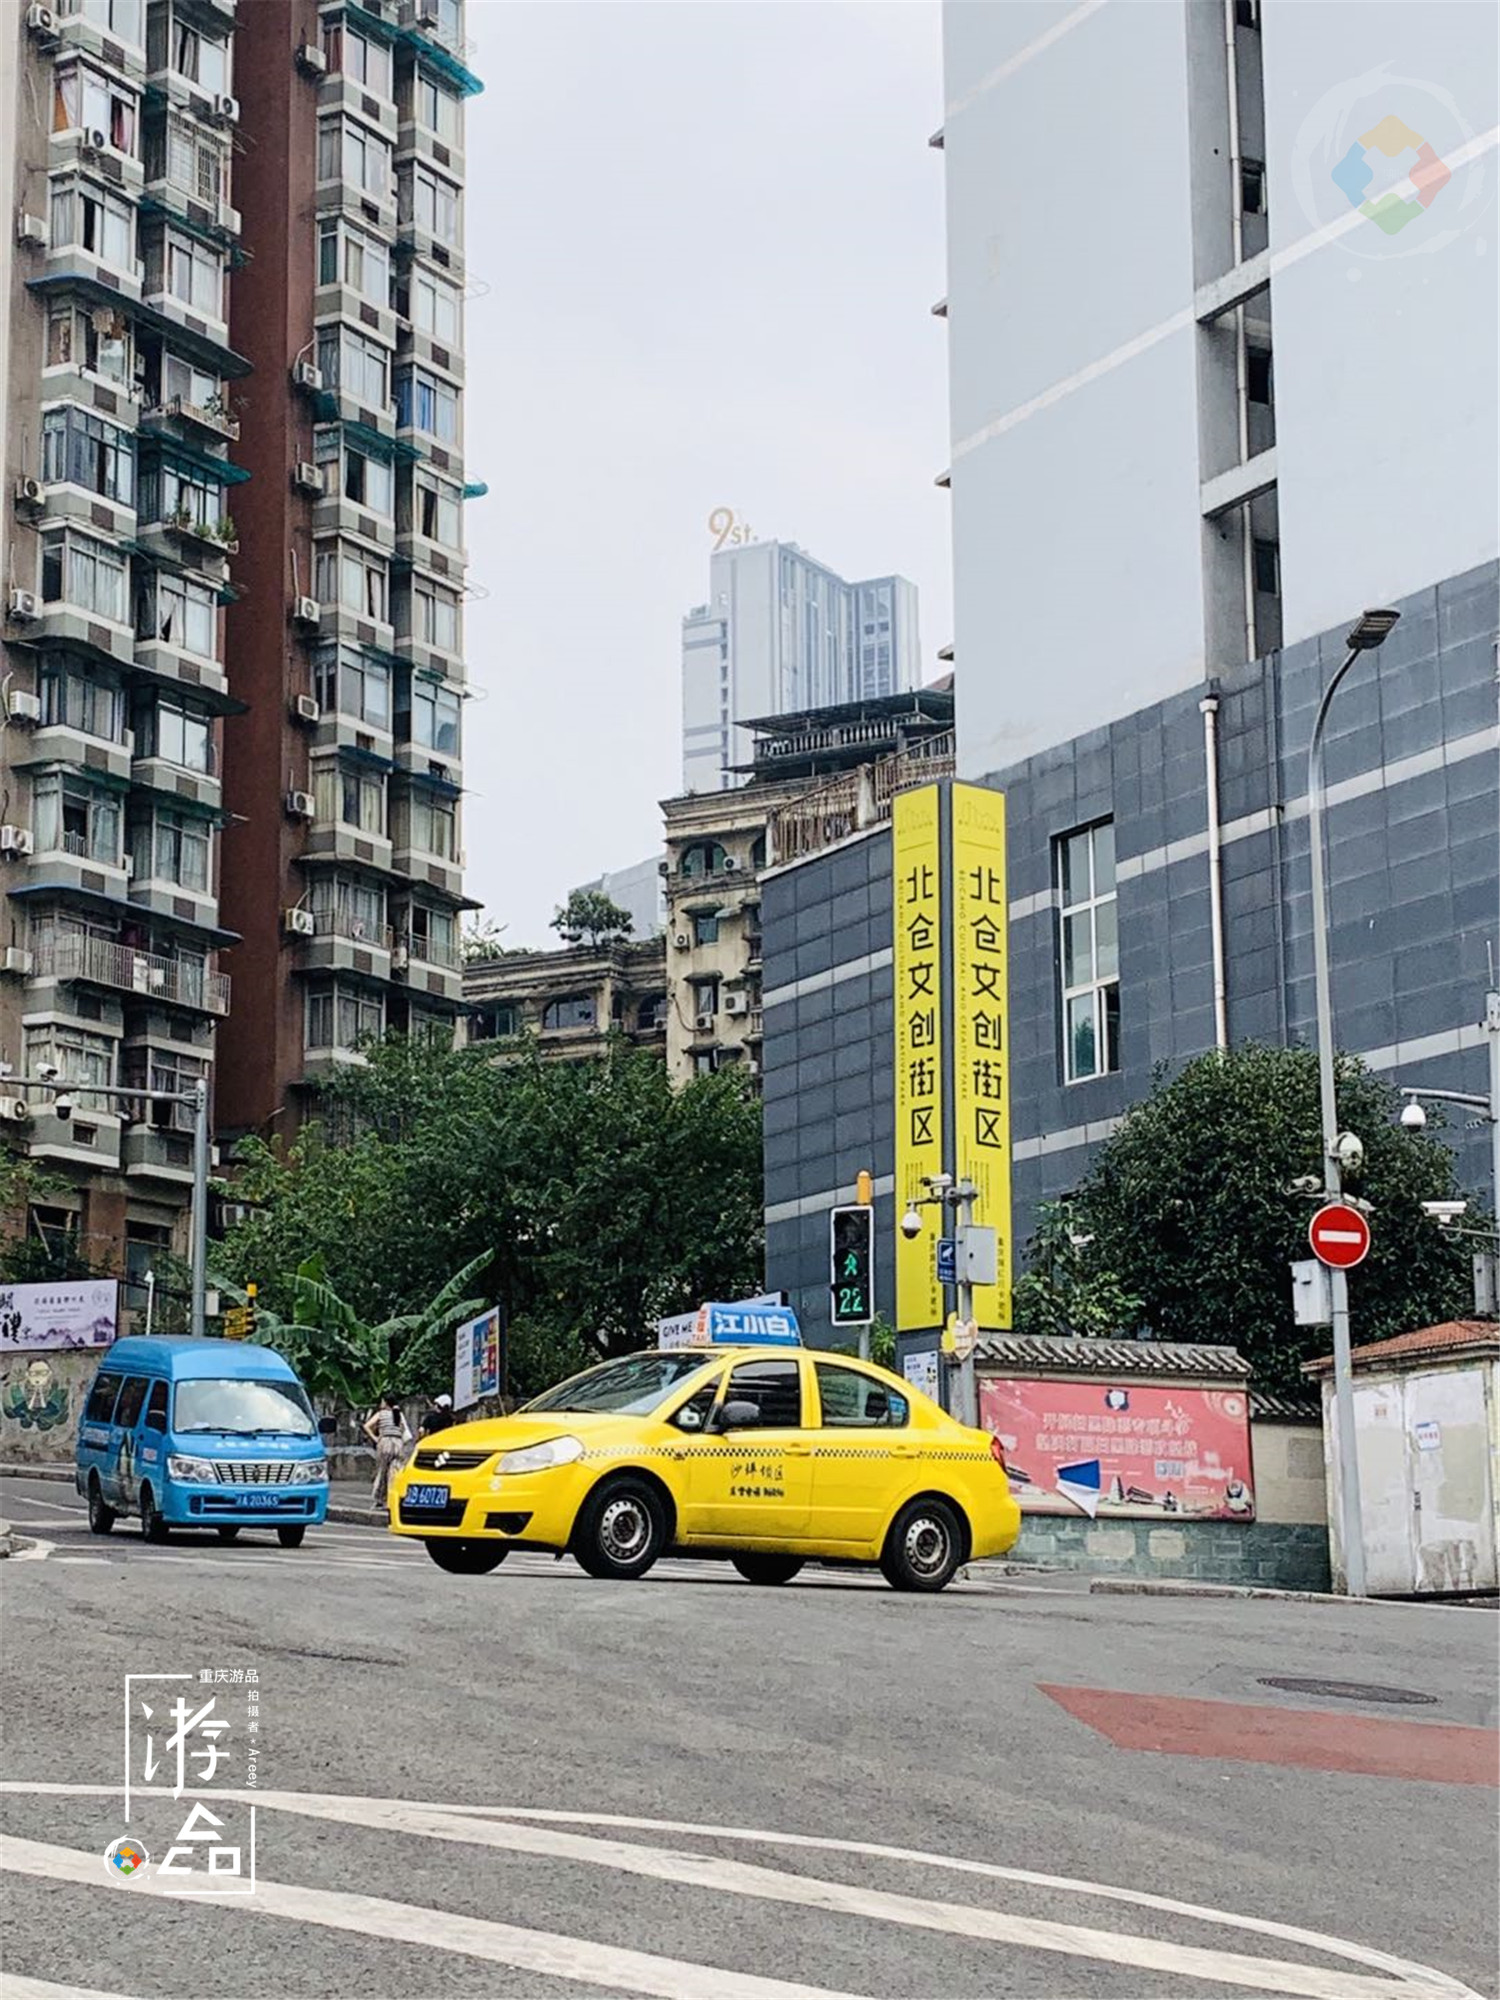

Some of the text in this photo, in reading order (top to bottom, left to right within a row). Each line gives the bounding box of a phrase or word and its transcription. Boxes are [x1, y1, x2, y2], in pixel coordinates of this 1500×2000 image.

[906, 865, 934, 1146] 北仓文创街区
[969, 866, 1002, 1149] 北仓文创街区
[714, 1311, 790, 1336] 江小白
[840, 1288, 863, 1312] 22
